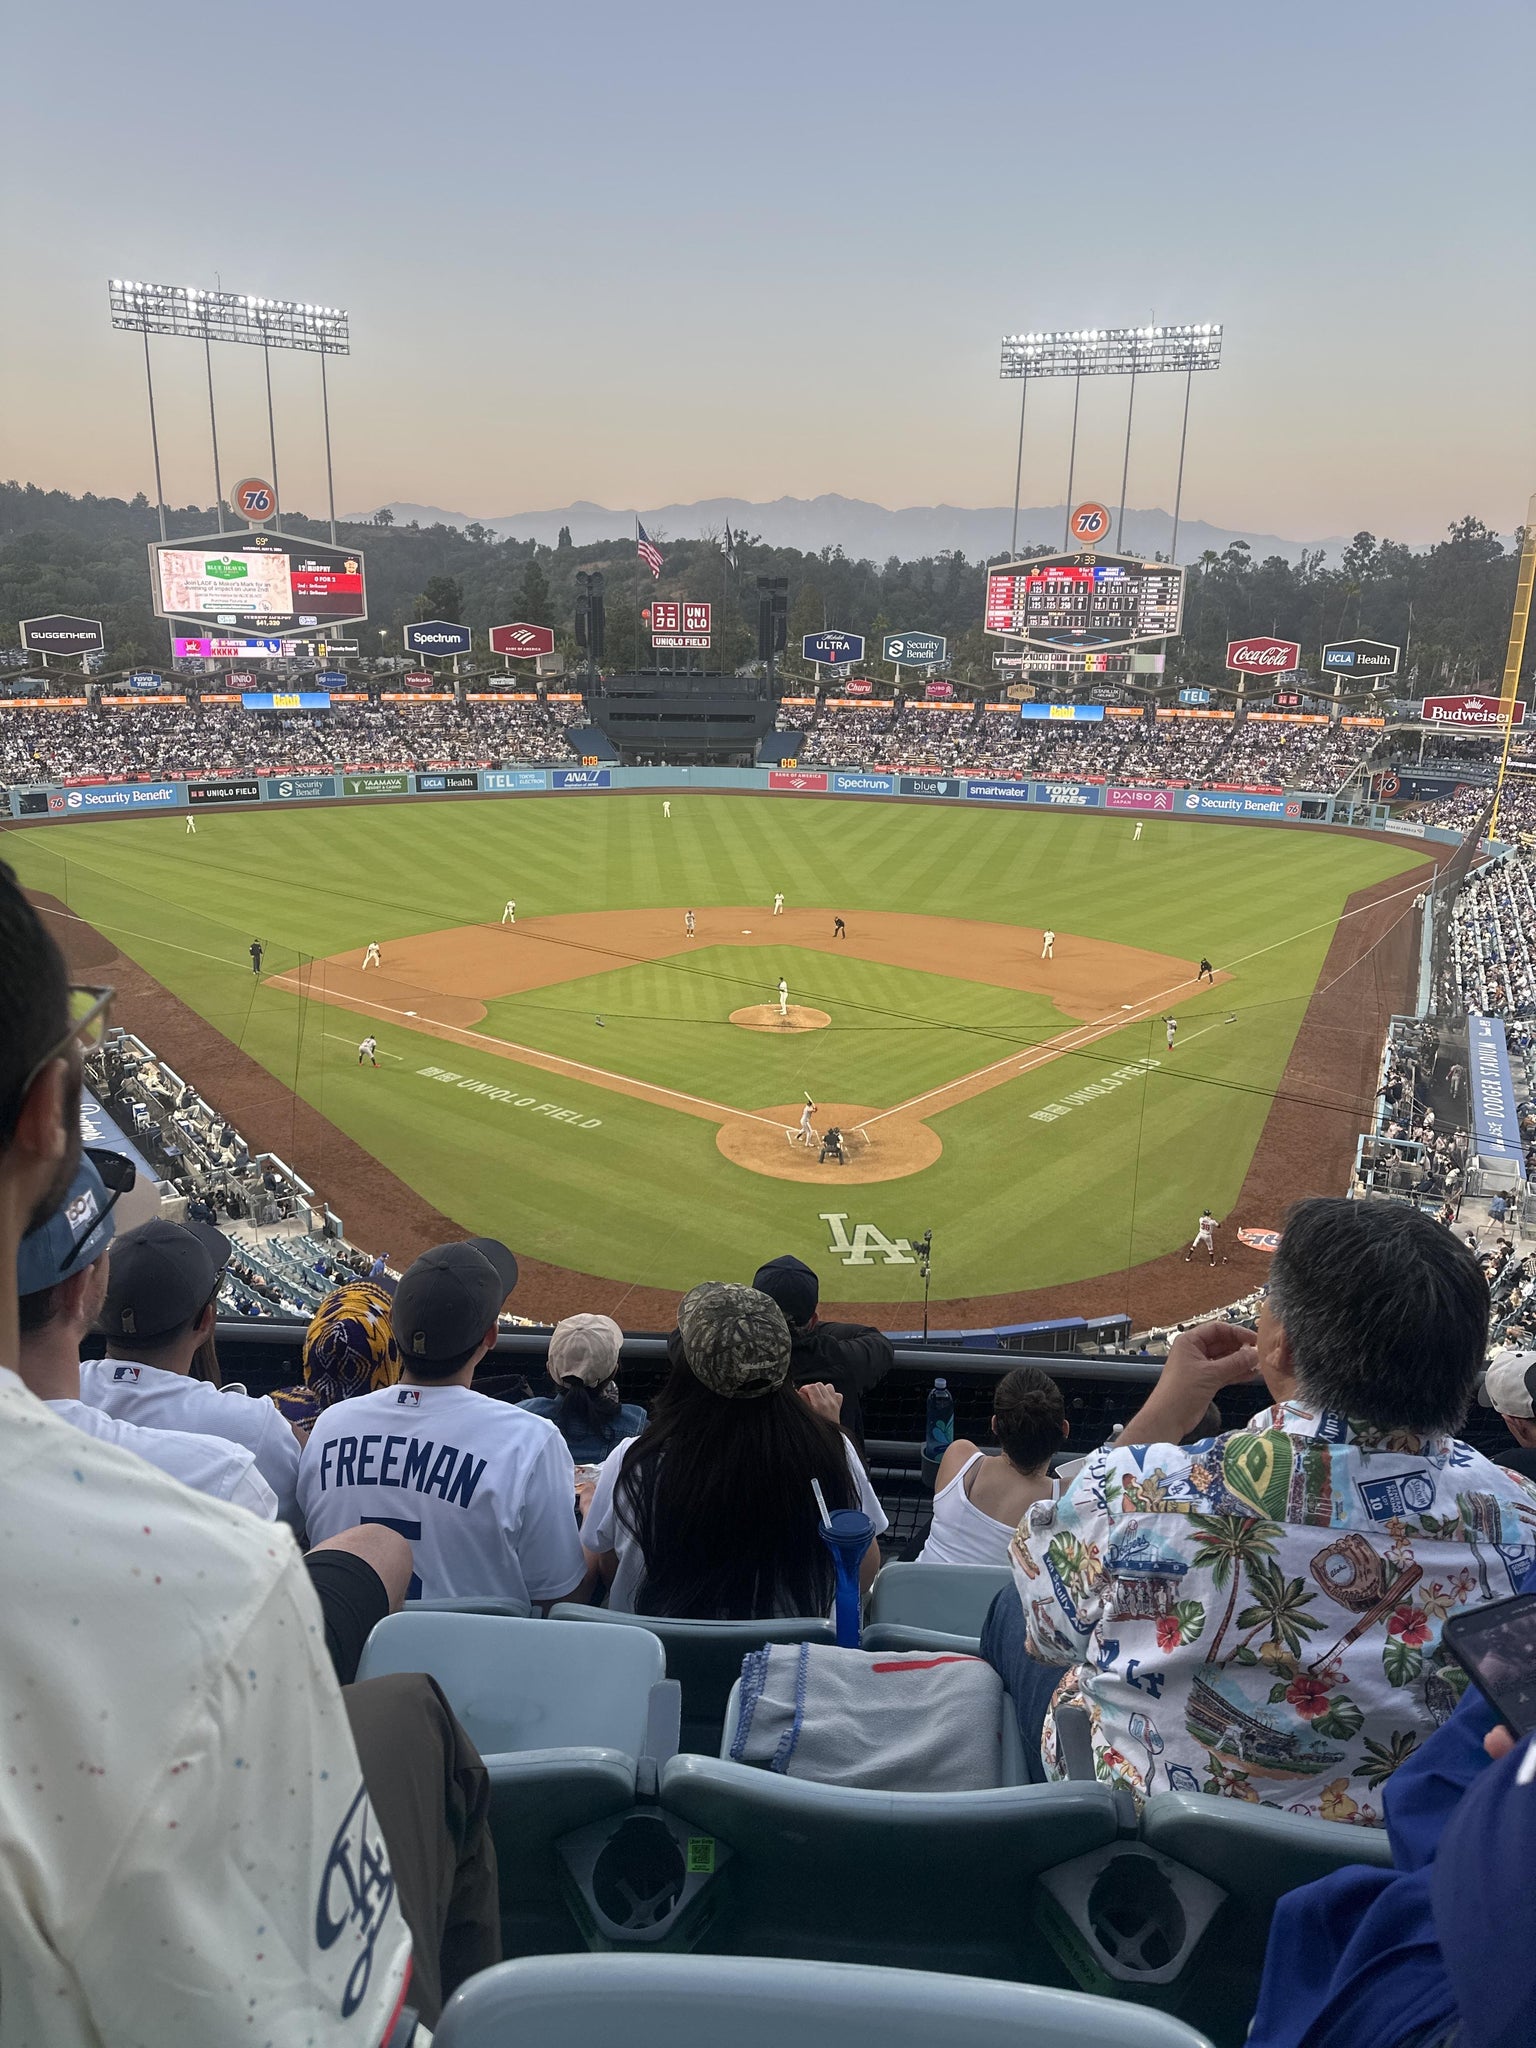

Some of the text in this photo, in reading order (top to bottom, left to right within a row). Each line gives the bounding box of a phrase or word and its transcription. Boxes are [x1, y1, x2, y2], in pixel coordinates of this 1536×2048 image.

[243, 490, 270, 511] 76
[1077, 511, 1102, 532] 76
[1074, 556, 1096, 565] 7:33
[687, 608, 706, 617] UNI
[687, 618, 707, 629] QLO
[414, 632, 461, 644] Spectrum
[656, 638, 683, 647] UNIQLO
[816, 641, 850, 650] ULTRA
[907, 640, 939, 650] Security
[907, 650, 934, 658] Benefit
[1233, 646, 1291, 666] Coca-Cola
[1328, 654, 1390, 665] UCLA Health
[232, 675, 252, 683] JINRO
[847, 683, 871, 692] Churu
[1183, 691, 1205, 701] TEL
[1431, 706, 1512, 724] Budweiser
[486, 775, 514, 788] TEL
[564, 773, 586, 782] ANA
[295, 780, 323, 790] Security
[838, 778, 886, 790] Spectrum
[914, 781, 936, 791] blue
[207, 788, 257, 797] UNIQLO FIELD
[970, 786, 1025, 797] smartwater
[1045, 786, 1080, 795] TOYO
[1113, 792, 1151, 800] DAISO
[85, 789, 171, 804] Security Benefit
[1050, 795, 1087, 805] TIRES
[50, 798, 63, 808] 76
[1202, 798, 1282, 812] Security Benefit
[1286, 804, 1300, 814] 76
[1478, 1042, 1500, 1077] STADIUM
[1060, 1058, 1162, 1106] UNIQLO FIELD
[456, 1079, 602, 1129] UNIQLO FIELD
[1481, 1079, 1505, 1118] DODGER
[818, 1213, 916, 1266] LA
[1319, 1408, 1338, 1444] cully
[320, 1435, 488, 1510] FREEMAN
[1370, 1498, 1383, 1510] 10
[1046, 1557, 1070, 1610] Vin Scully
